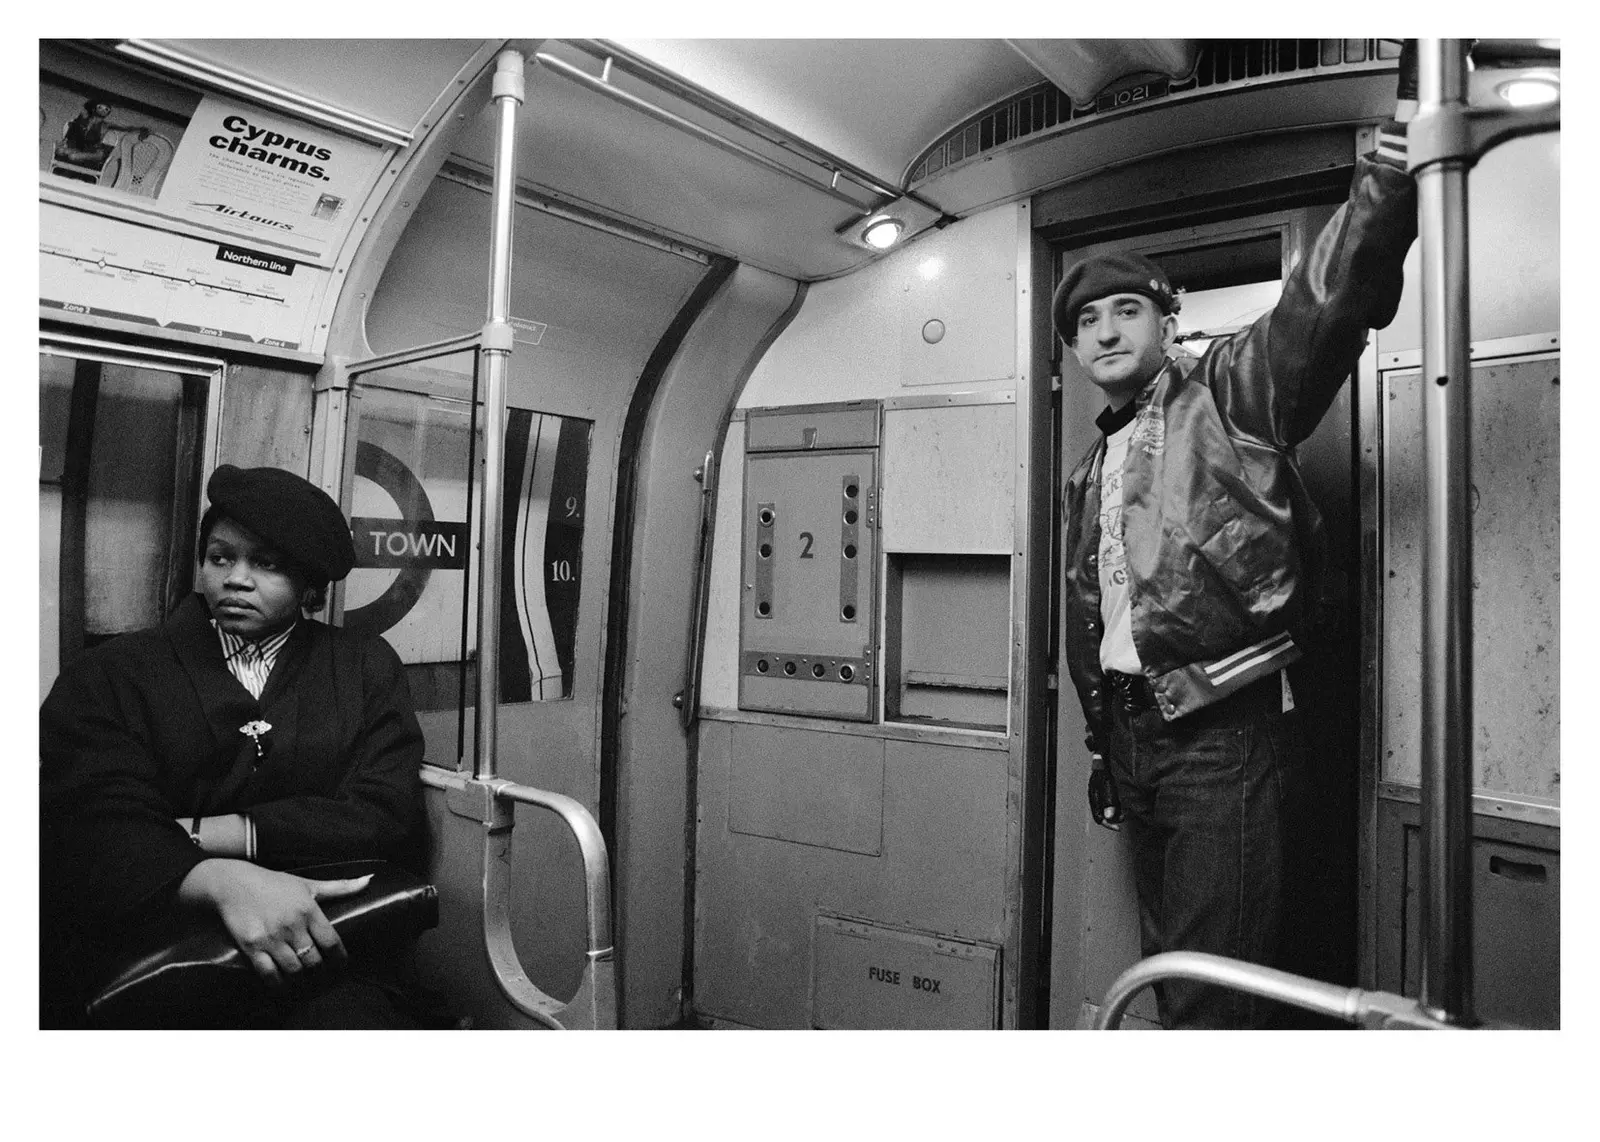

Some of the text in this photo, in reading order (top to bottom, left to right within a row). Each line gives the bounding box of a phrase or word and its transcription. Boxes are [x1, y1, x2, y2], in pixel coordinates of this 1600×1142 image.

[1114, 84, 1149, 106] 1021
[223, 115, 332, 161] Cyprus
[209, 135, 330, 182] charms.
[193, 201, 295, 231] Airtours
[223, 250, 287, 273] Northern line
[63, 302, 91, 314] Zone 2
[200, 327, 219, 336] Zone
[264, 338, 280, 347] Zone
[565, 496, 581, 519] 9.
[369, 531, 456, 557] TOWN
[799, 532, 814, 559] 2
[551, 559, 576, 582] 10.
[868, 966, 941, 994] FUSE BOX
